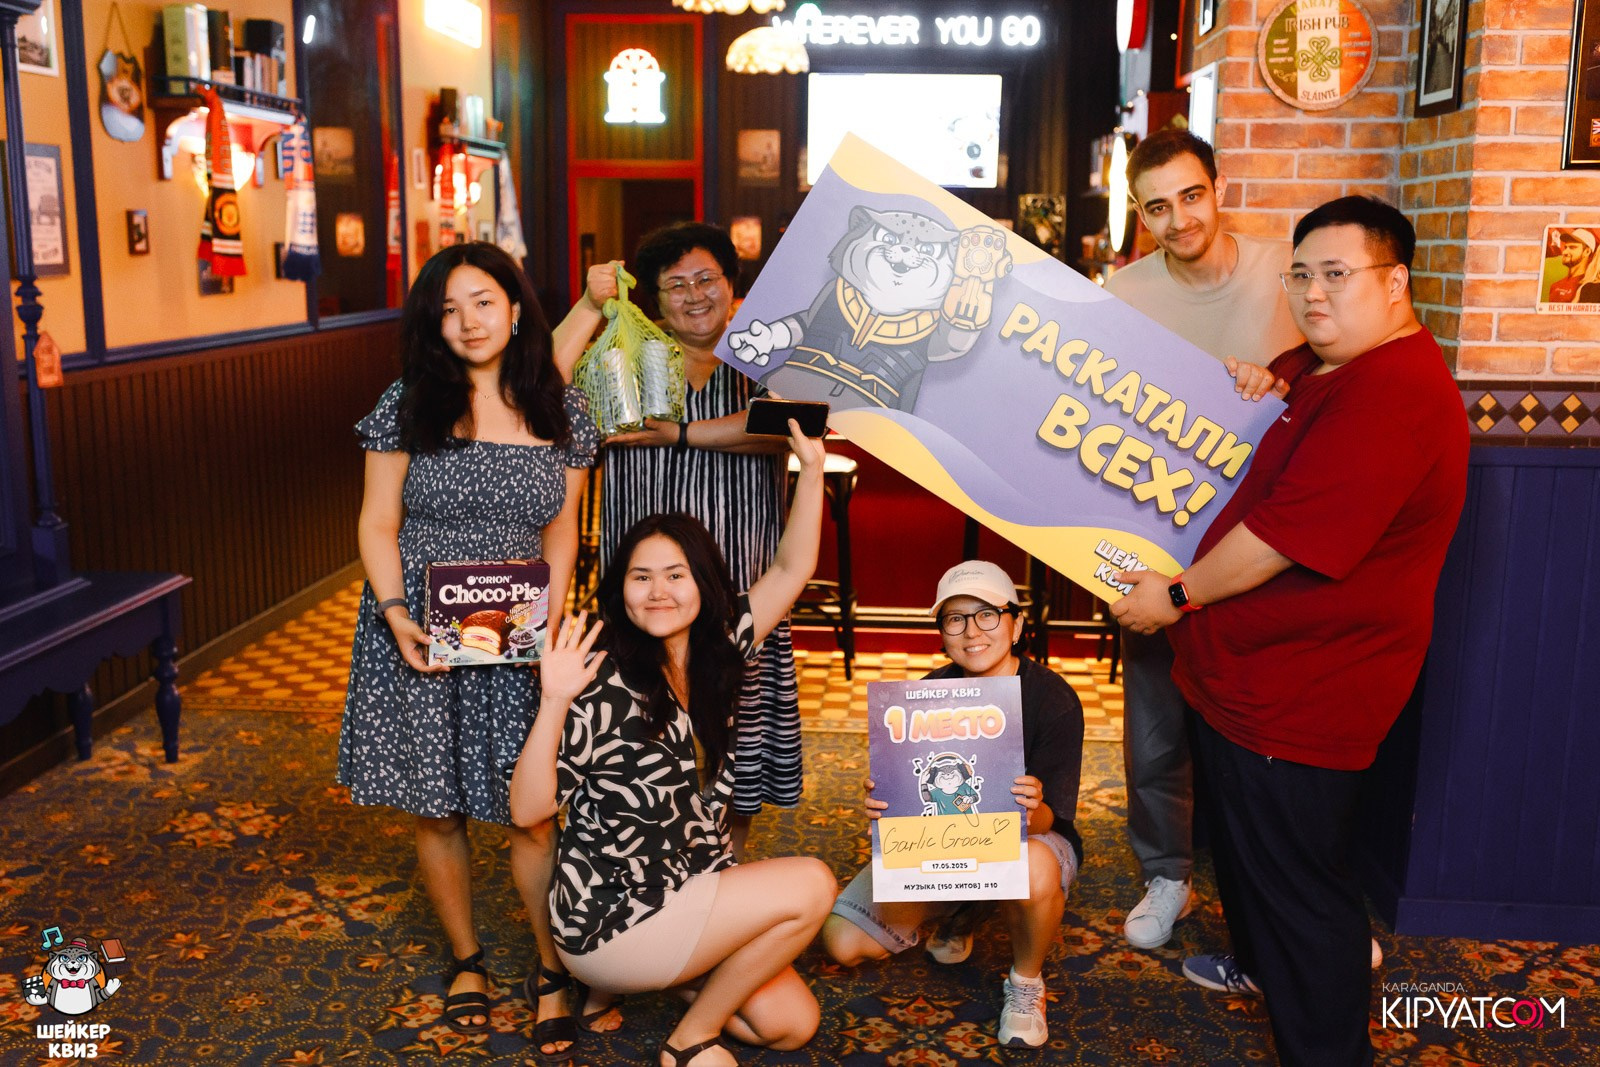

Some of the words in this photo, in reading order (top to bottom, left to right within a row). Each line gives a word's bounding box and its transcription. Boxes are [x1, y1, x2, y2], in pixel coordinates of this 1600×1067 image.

[935, 15, 993, 47] YOU
[1000, 15, 1041, 47] GO
[1285, 17, 1320, 33] IRISH
[1324, 15, 1350, 30] PUB
[999, 302, 1254, 481] РАСКАТАЛИ
[1036, 392, 1218, 528] ВСЕХ!
[905, 687, 949, 700] ШЕЙКЕР
[951, 687, 981, 698] КВИЗ
[885, 706, 906, 743] 1
[909, 705, 1006, 742] МЕСТО
[883, 826, 936, 855] Garlic
[941, 823, 993, 849] Groove
[931, 862, 969, 870] 17.05.2025
[903, 883, 936, 891] МУЗЫКА
[937, 883, 953, 891] [150
[954, 882, 981, 890] ХИТОВ]
